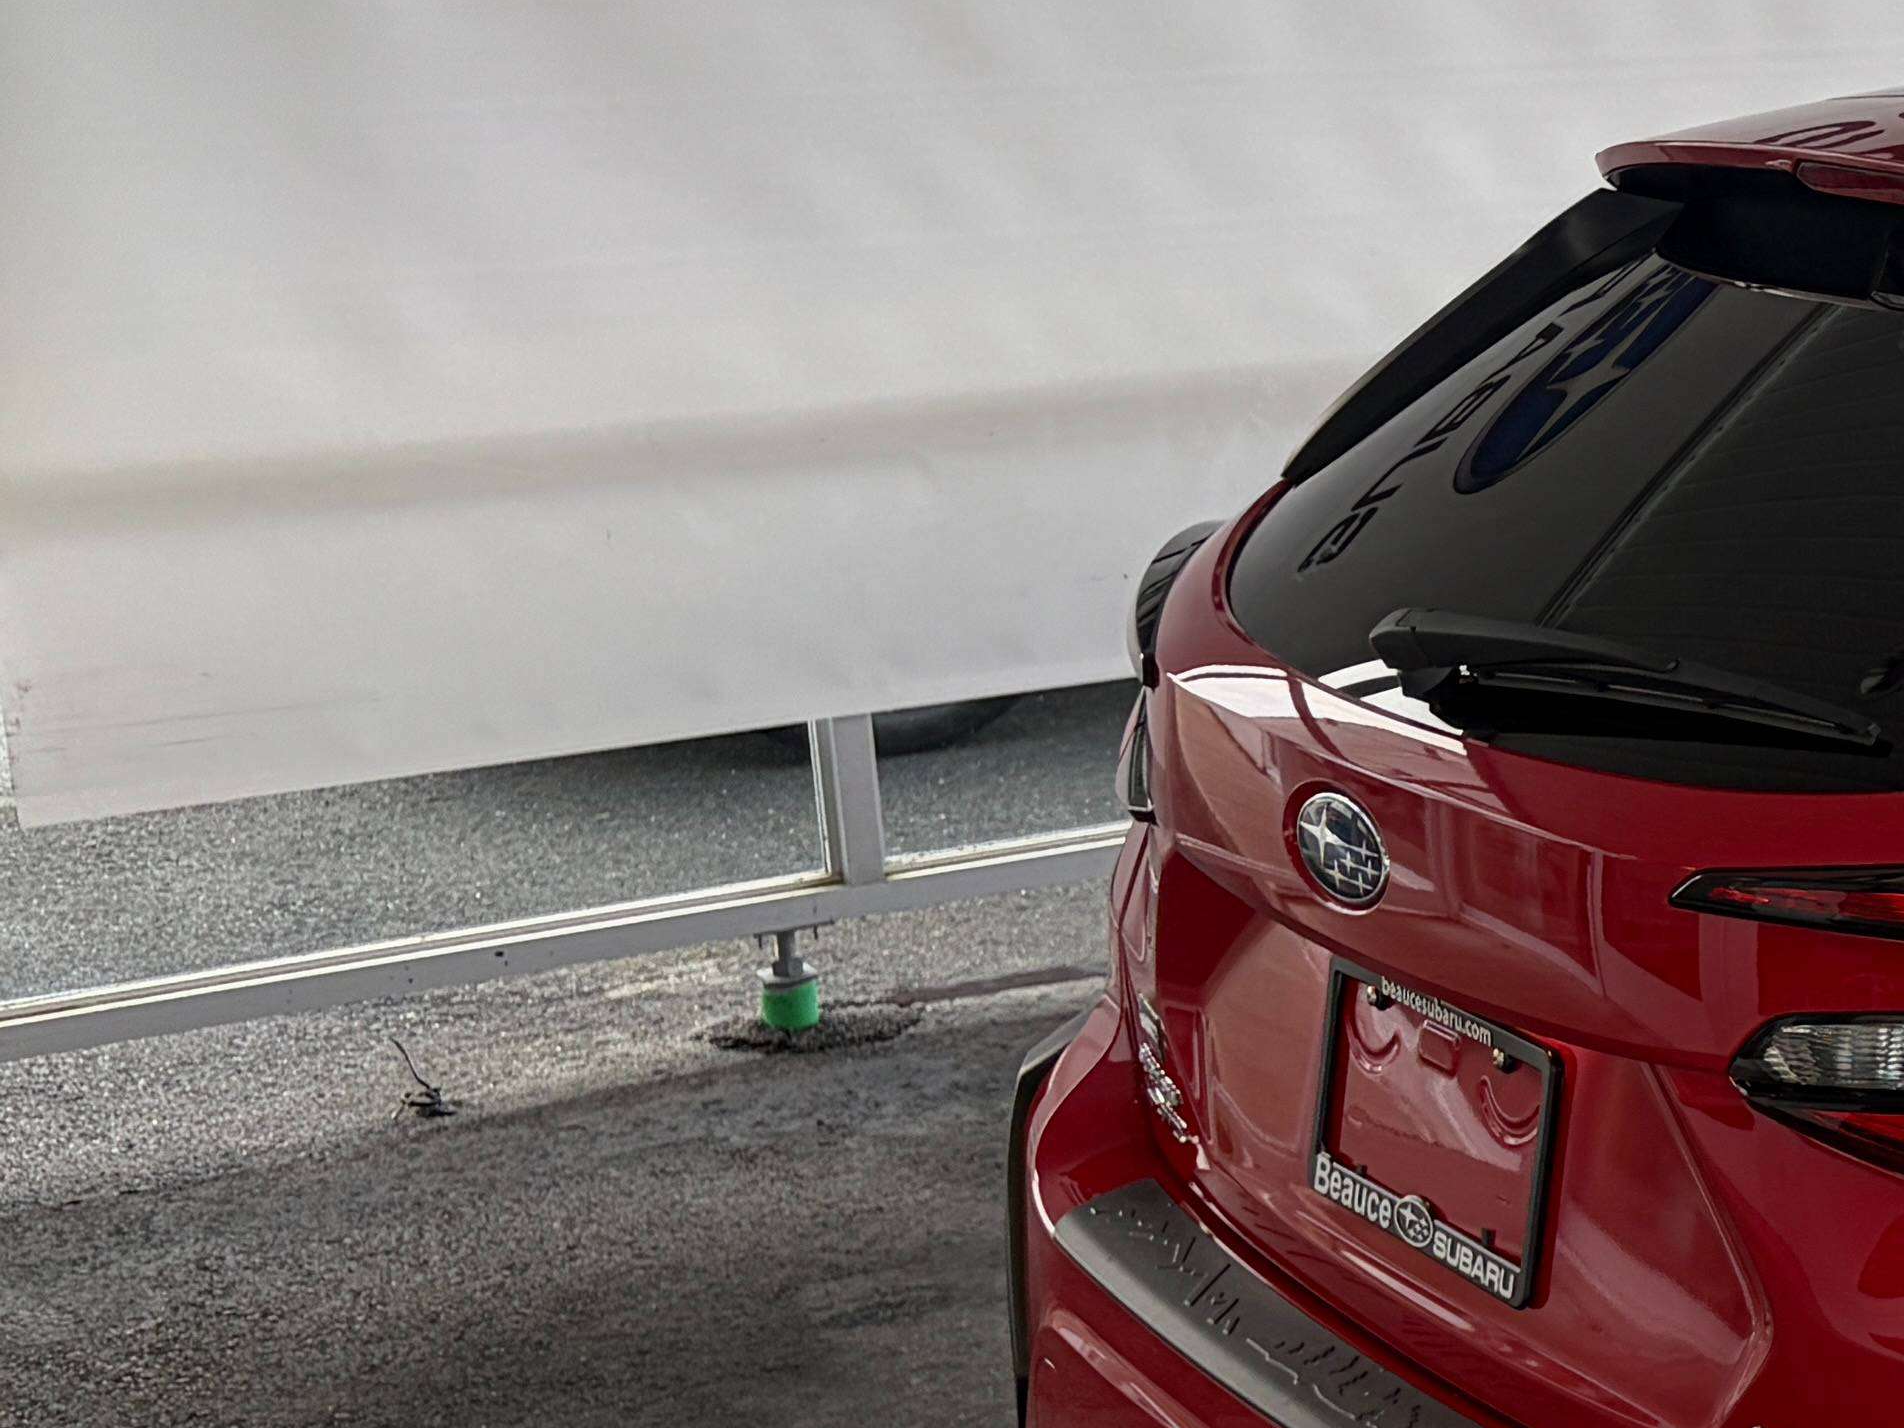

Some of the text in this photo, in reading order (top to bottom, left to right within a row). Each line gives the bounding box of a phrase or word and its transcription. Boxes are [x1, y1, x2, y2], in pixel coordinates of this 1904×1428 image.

[1381, 975, 1492, 1046] beaucesubaru.com
[1313, 1153, 1515, 1300] Beauce SUBARU
